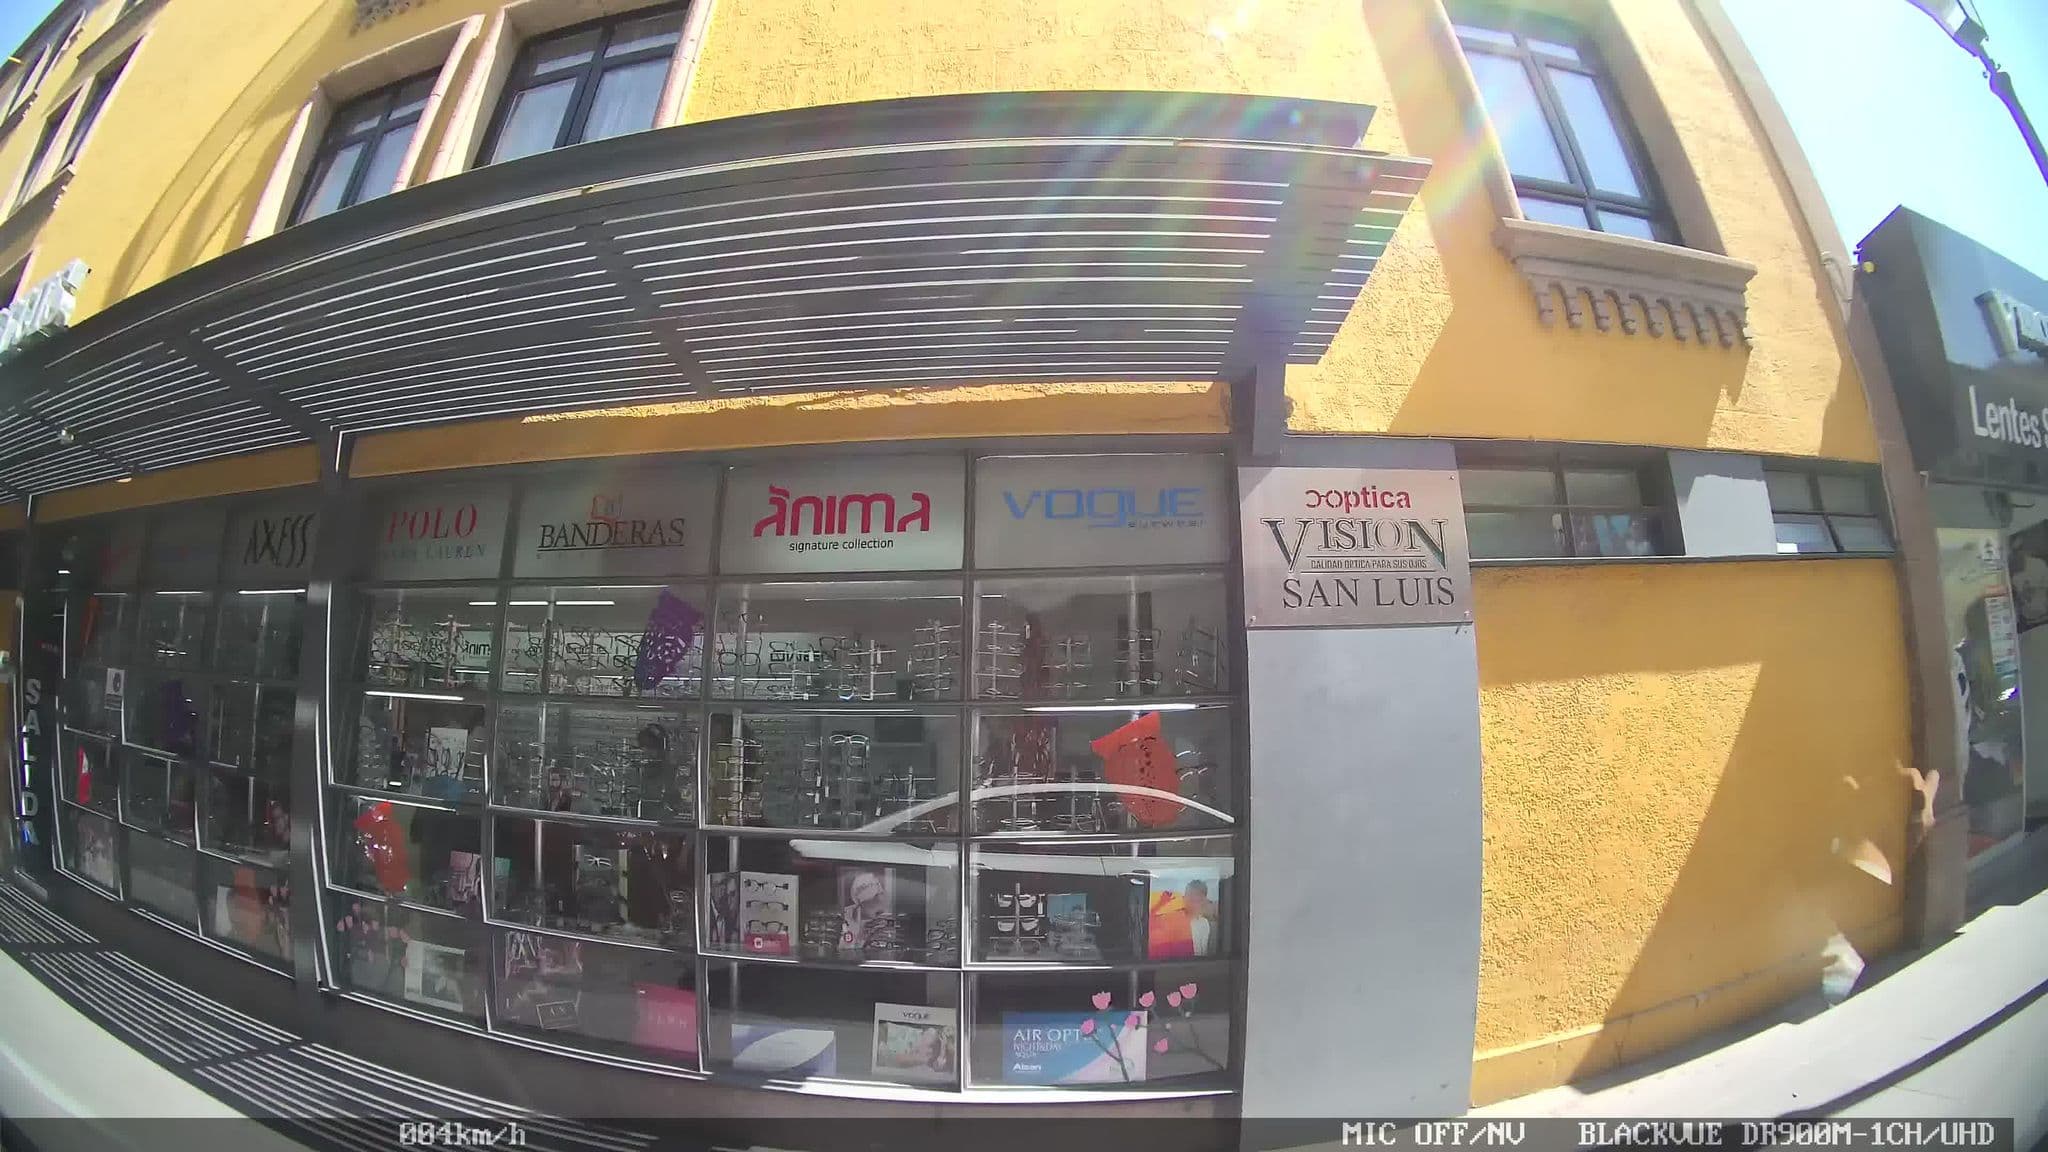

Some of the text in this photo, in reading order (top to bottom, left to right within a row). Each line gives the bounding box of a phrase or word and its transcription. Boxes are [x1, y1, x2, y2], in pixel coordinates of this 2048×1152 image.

[1969, 385, 2042, 448] Lentes
[386, 503, 479, 544] POLO
[537, 518, 686, 550] BANDERAS
[789, 538, 894, 553] signature collection
[1260, 516, 1449, 573] VISION
[1311, 560, 1343, 569] CALIDAD
[1344, 560, 1370, 569] OPTICA
[1372, 559, 1392, 569] PARA
[1393, 559, 1407, 569] SUS
[1282, 577, 1456, 609] SAN LUIS
[20, 677, 43, 847] SALIDA
[1012, 1028, 1097, 1042] AIR OPT
